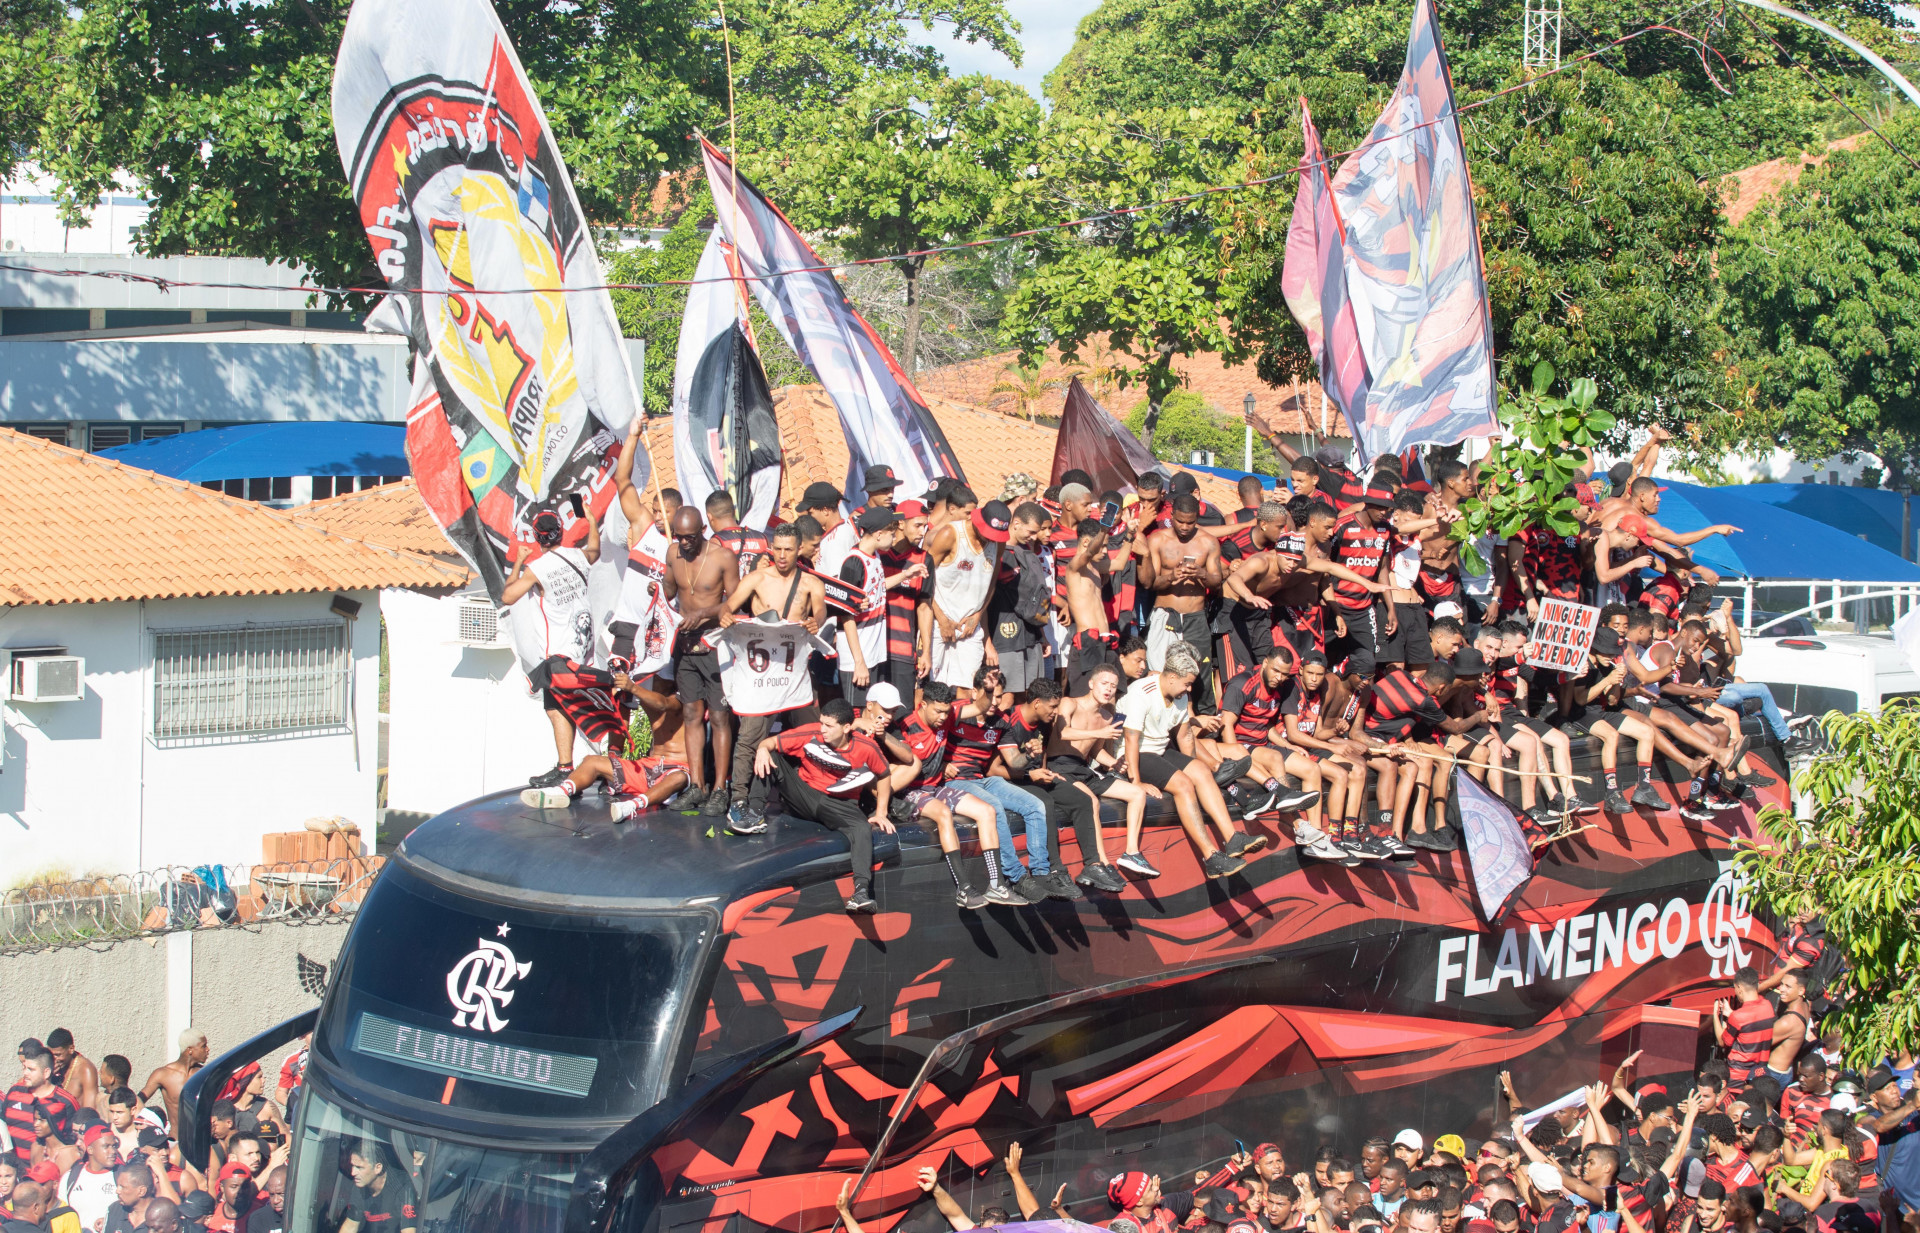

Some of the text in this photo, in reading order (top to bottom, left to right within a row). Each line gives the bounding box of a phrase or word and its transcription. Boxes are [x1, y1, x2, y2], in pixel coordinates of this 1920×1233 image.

[1346, 555, 1381, 568] pixbet
[1543, 603, 1592, 628] NINGUÉM
[1535, 622, 1591, 648] MORRE NOS
[747, 639, 770, 673] 6
[780, 641, 795, 672] 1
[1531, 641, 1585, 671] DEVENDO!
[754, 677, 789, 687] FOI POUCO
[1434, 897, 1691, 1003] FLAMENGO
[395, 1025, 553, 1082] FLAMENGO
